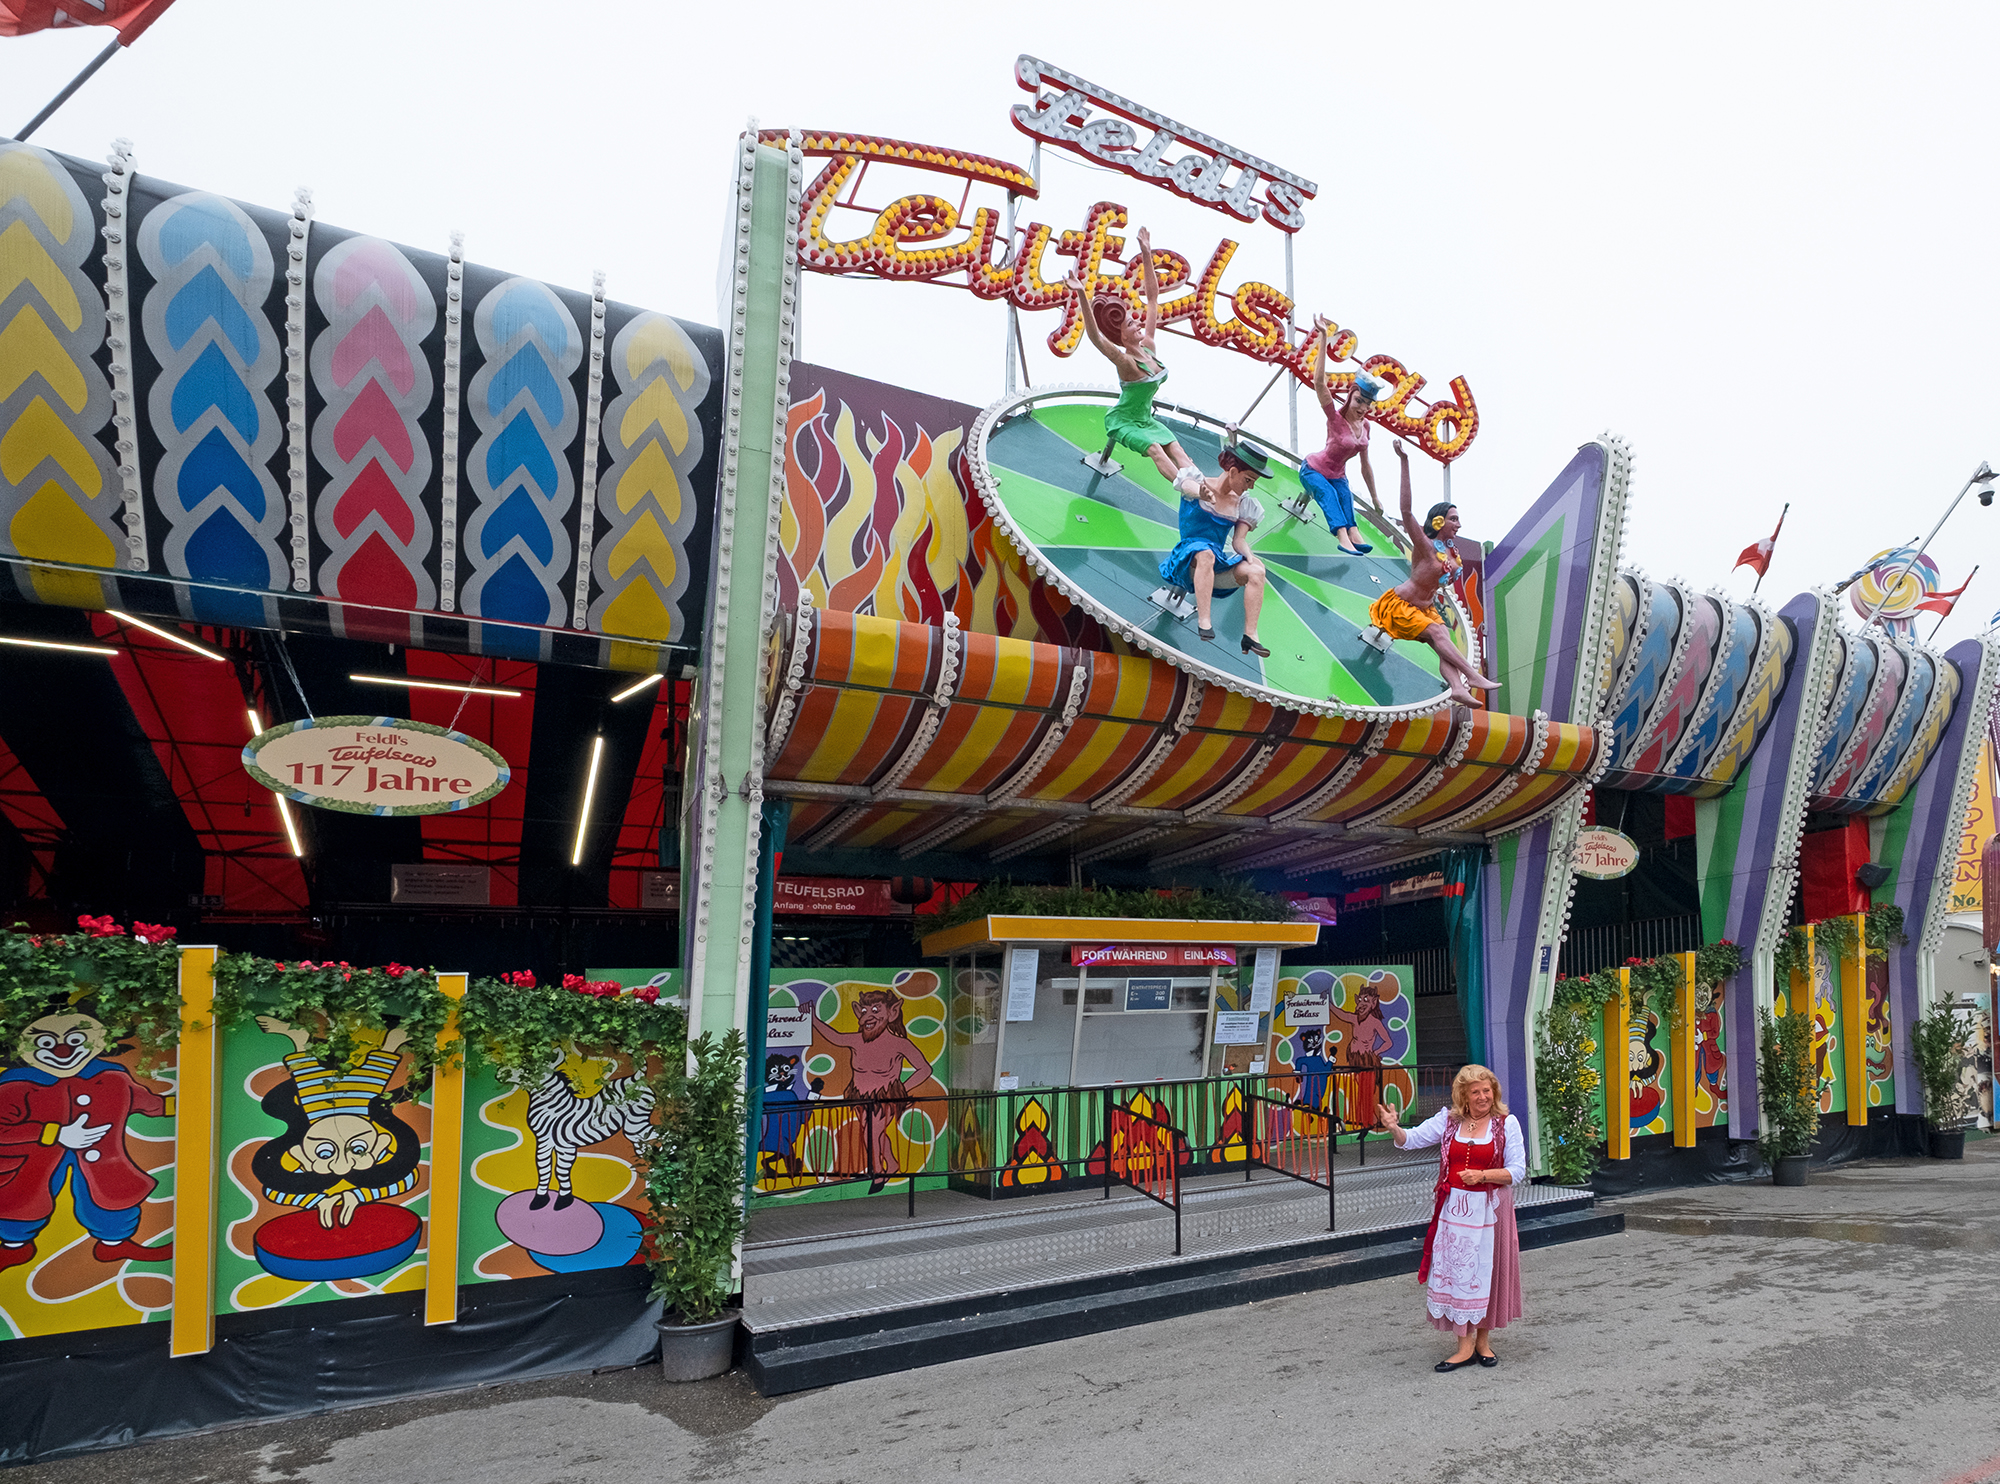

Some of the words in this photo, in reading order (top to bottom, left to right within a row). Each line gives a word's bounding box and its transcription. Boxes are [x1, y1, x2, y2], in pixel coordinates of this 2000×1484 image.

[740, 129, 1479, 463] Teufelsrad
[356, 732, 408, 746] Feldl's
[328, 746, 437, 768] Teufelsrad
[286, 762, 355, 787] 117
[364, 767, 472, 794] Jahre
[1577, 852, 1592, 865] 17
[1595, 853, 1628, 867] Jahre
[776, 881, 865, 898] TEUFELSRAD
[773, 902, 804, 910] Anfang
[1081, 949, 1168, 960] FORTWÄHREND
[1184, 950, 1228, 960] EINLASS
[1293, 1009, 1320, 1018] Einlass
